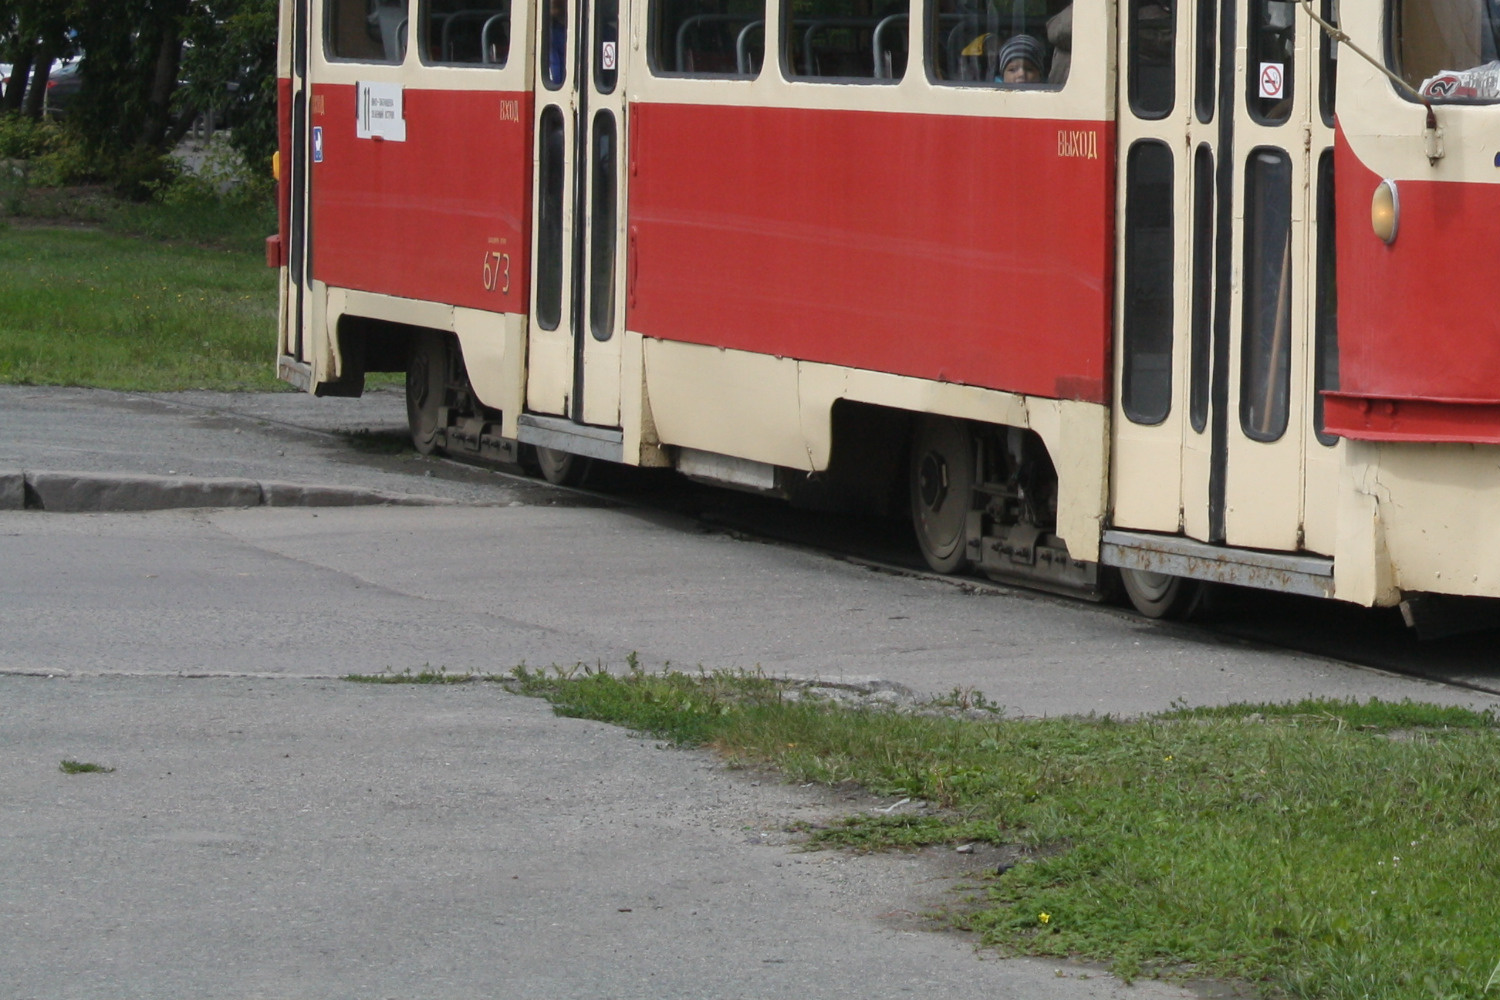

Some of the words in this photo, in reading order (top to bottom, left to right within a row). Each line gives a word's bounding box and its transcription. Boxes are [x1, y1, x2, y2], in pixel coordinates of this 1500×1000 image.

[363, 87, 371, 131] 11
[500, 100, 519, 122] ВХОД
[1057, 130, 1098, 160] ВЫХОД
[483, 250, 510, 293] 673
